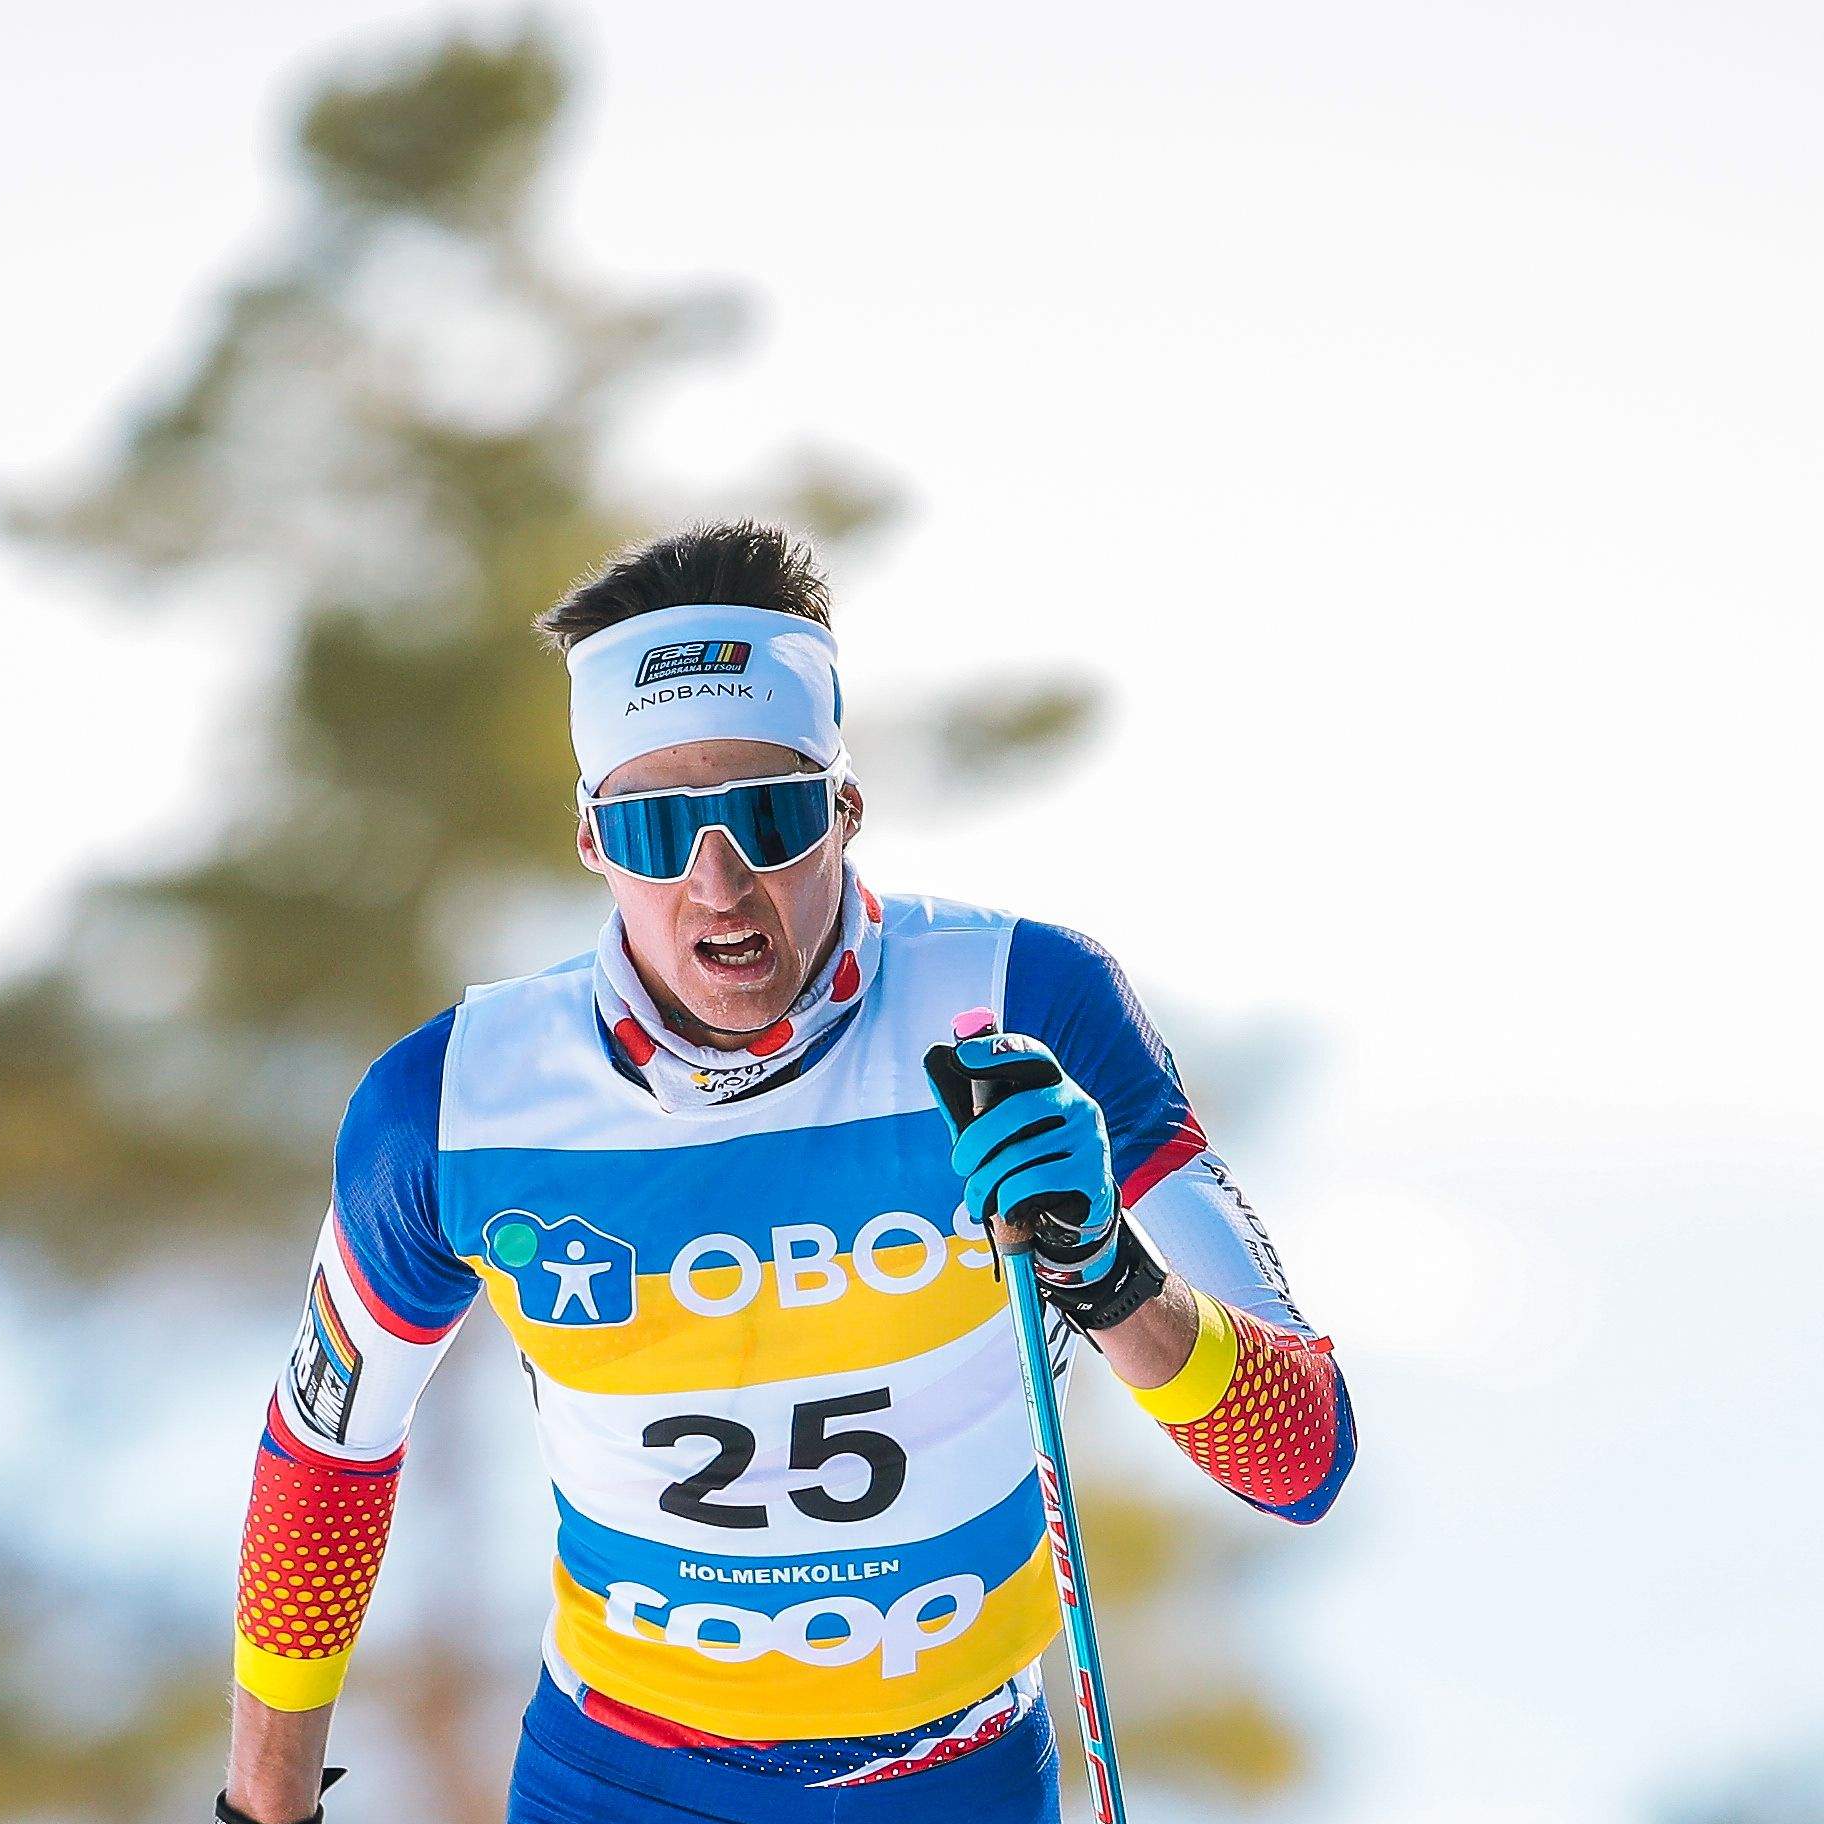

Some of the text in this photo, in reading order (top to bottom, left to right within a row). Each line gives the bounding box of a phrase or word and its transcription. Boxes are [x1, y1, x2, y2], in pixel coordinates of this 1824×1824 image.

[625, 683, 754, 716] ANDBANK
[642, 1386, 908, 1529] 25
[679, 1559, 901, 1585] HOLMENKOLLEN
[604, 1573, 986, 1680] coop
